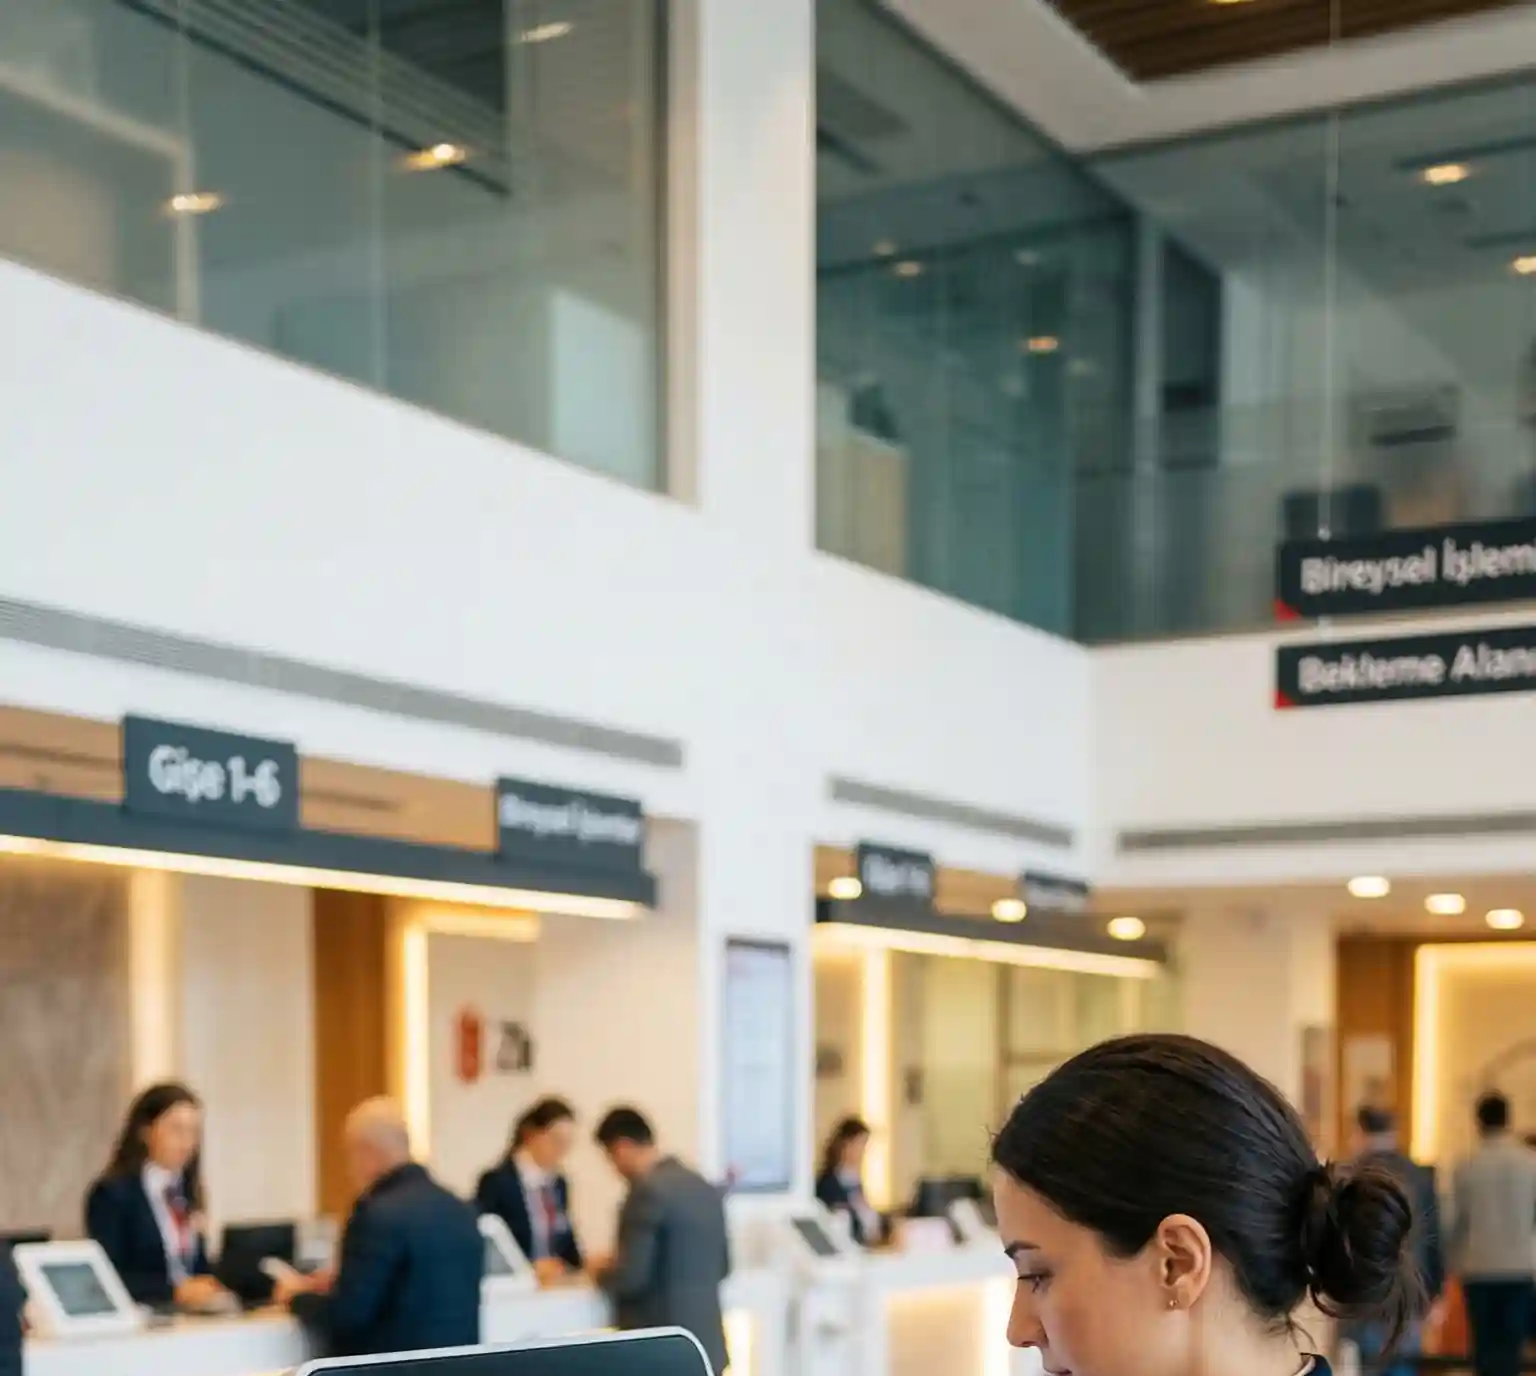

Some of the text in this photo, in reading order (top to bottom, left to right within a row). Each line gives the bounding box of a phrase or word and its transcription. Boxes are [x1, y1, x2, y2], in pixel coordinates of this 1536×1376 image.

[1301, 537, 1536, 594] Bireysel İşlem
[1298, 653, 1446, 692] Bekleme
[148, 745, 282, 808] Gişe 1-6
